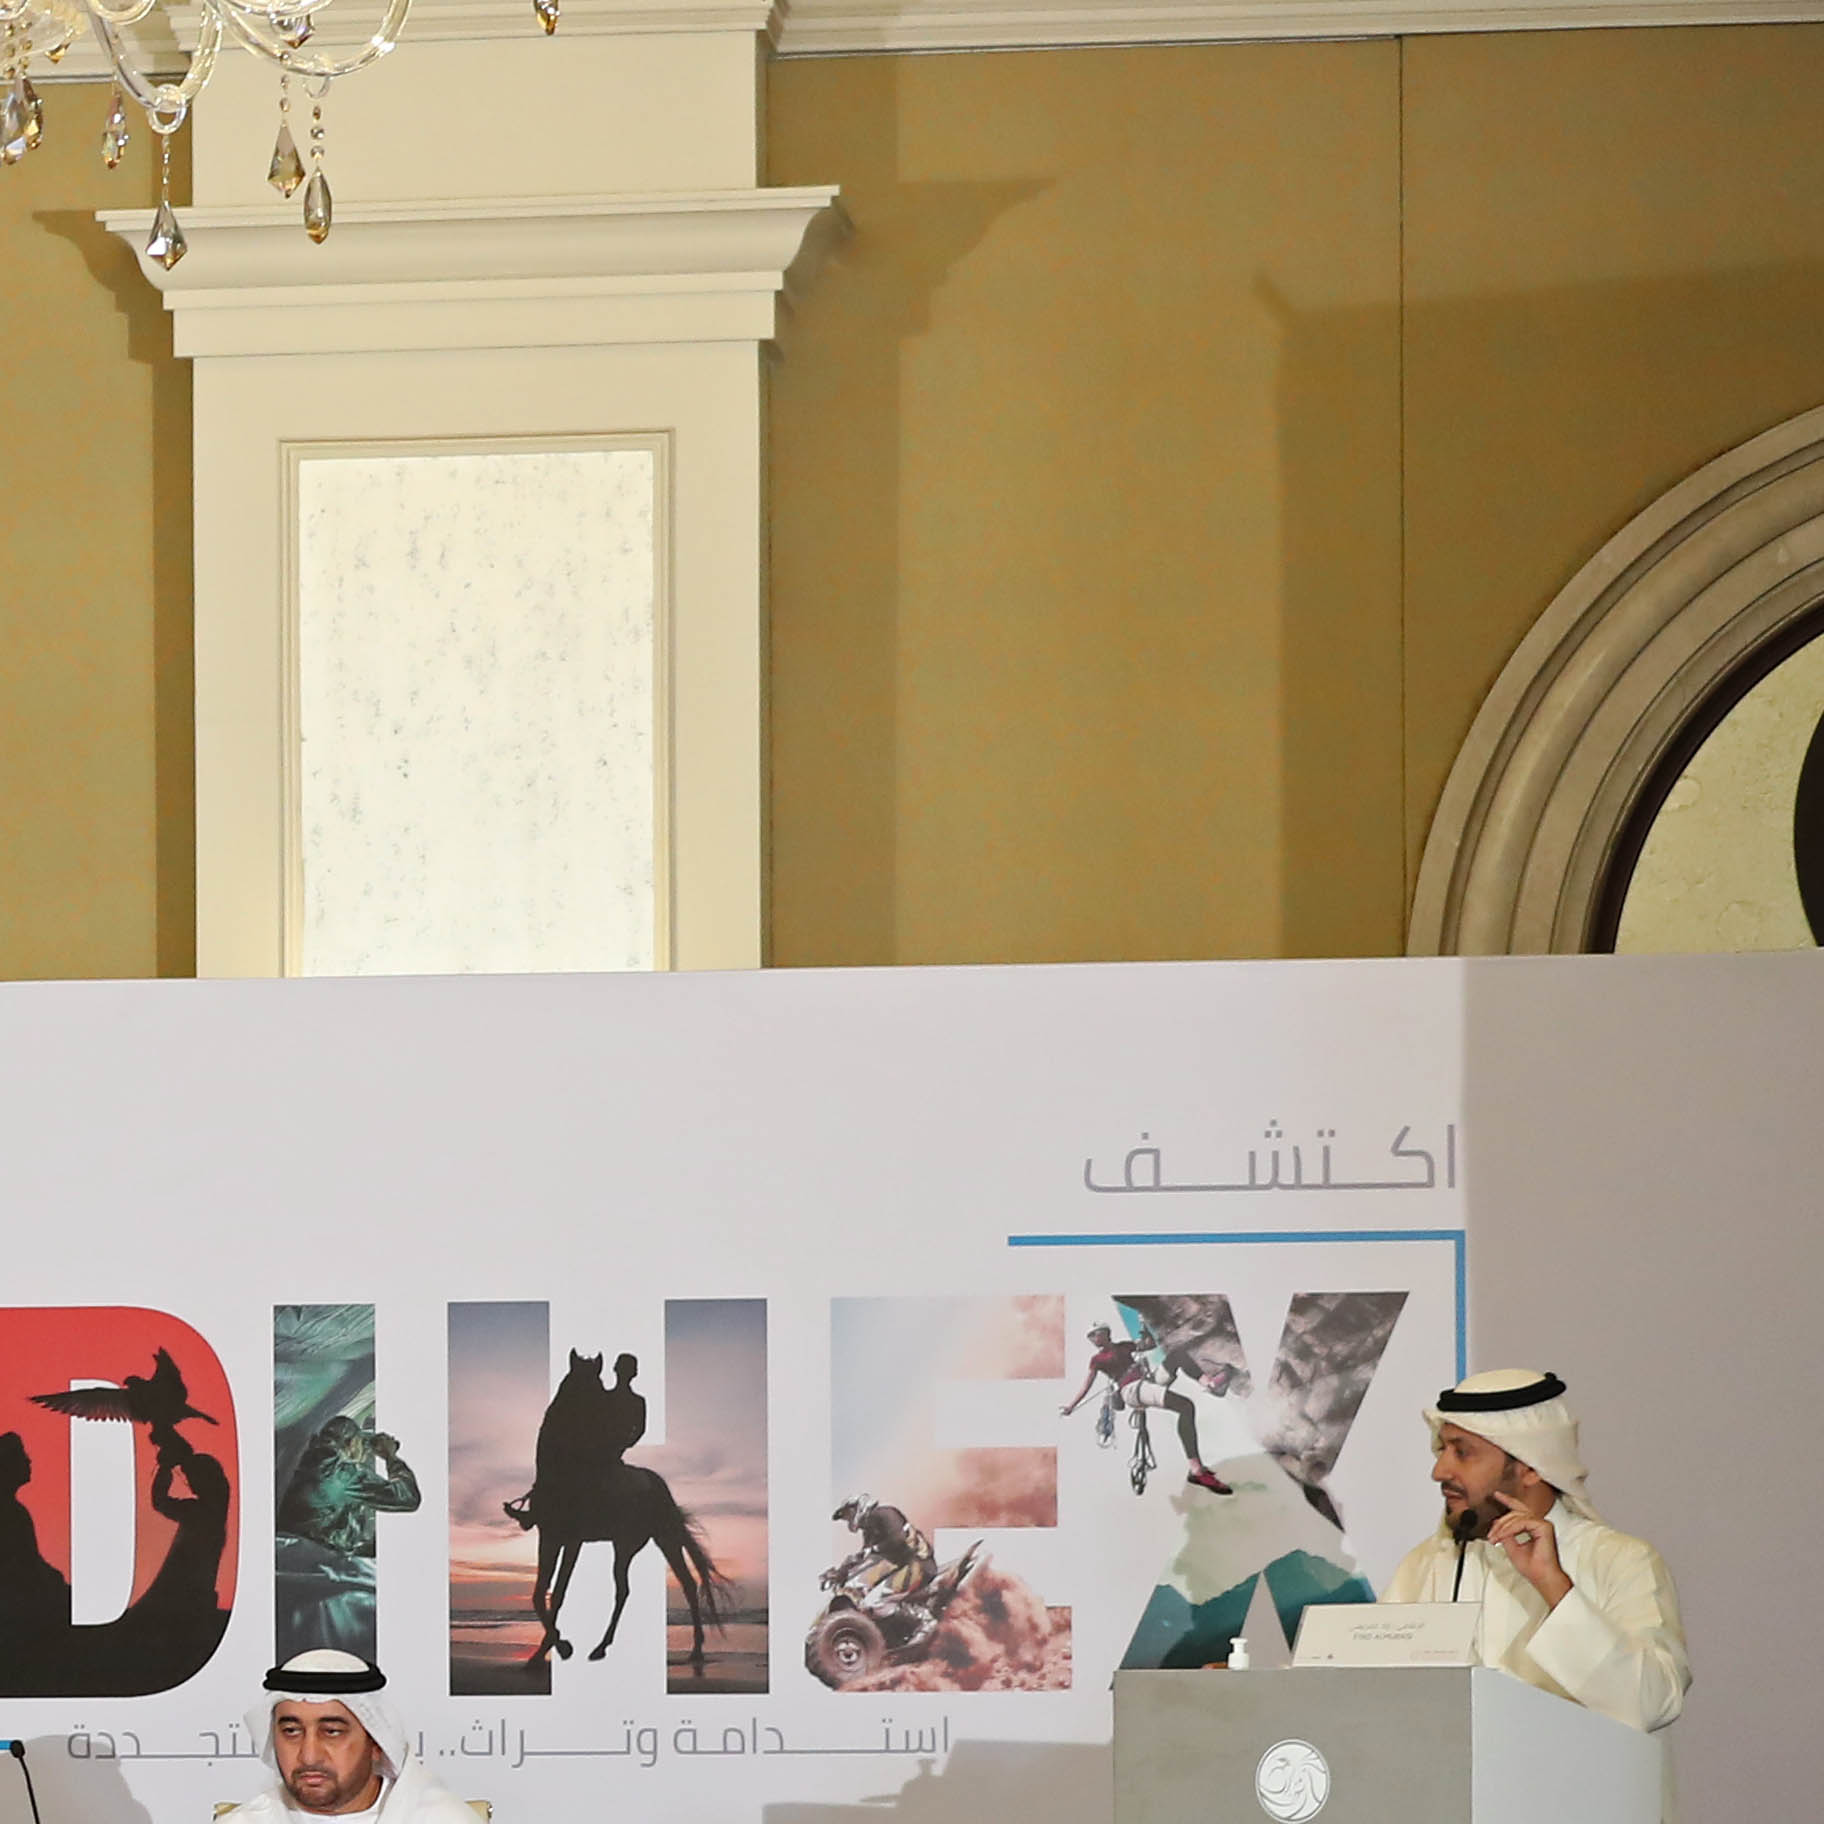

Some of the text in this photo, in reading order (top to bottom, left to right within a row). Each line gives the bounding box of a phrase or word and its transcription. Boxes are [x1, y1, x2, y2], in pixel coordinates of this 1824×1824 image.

[1082, 1117, 1460, 1197] اكتشف
[66, 1721, 261, 1771] تجددة
[674, 1715, 955, 1761] استدامة
